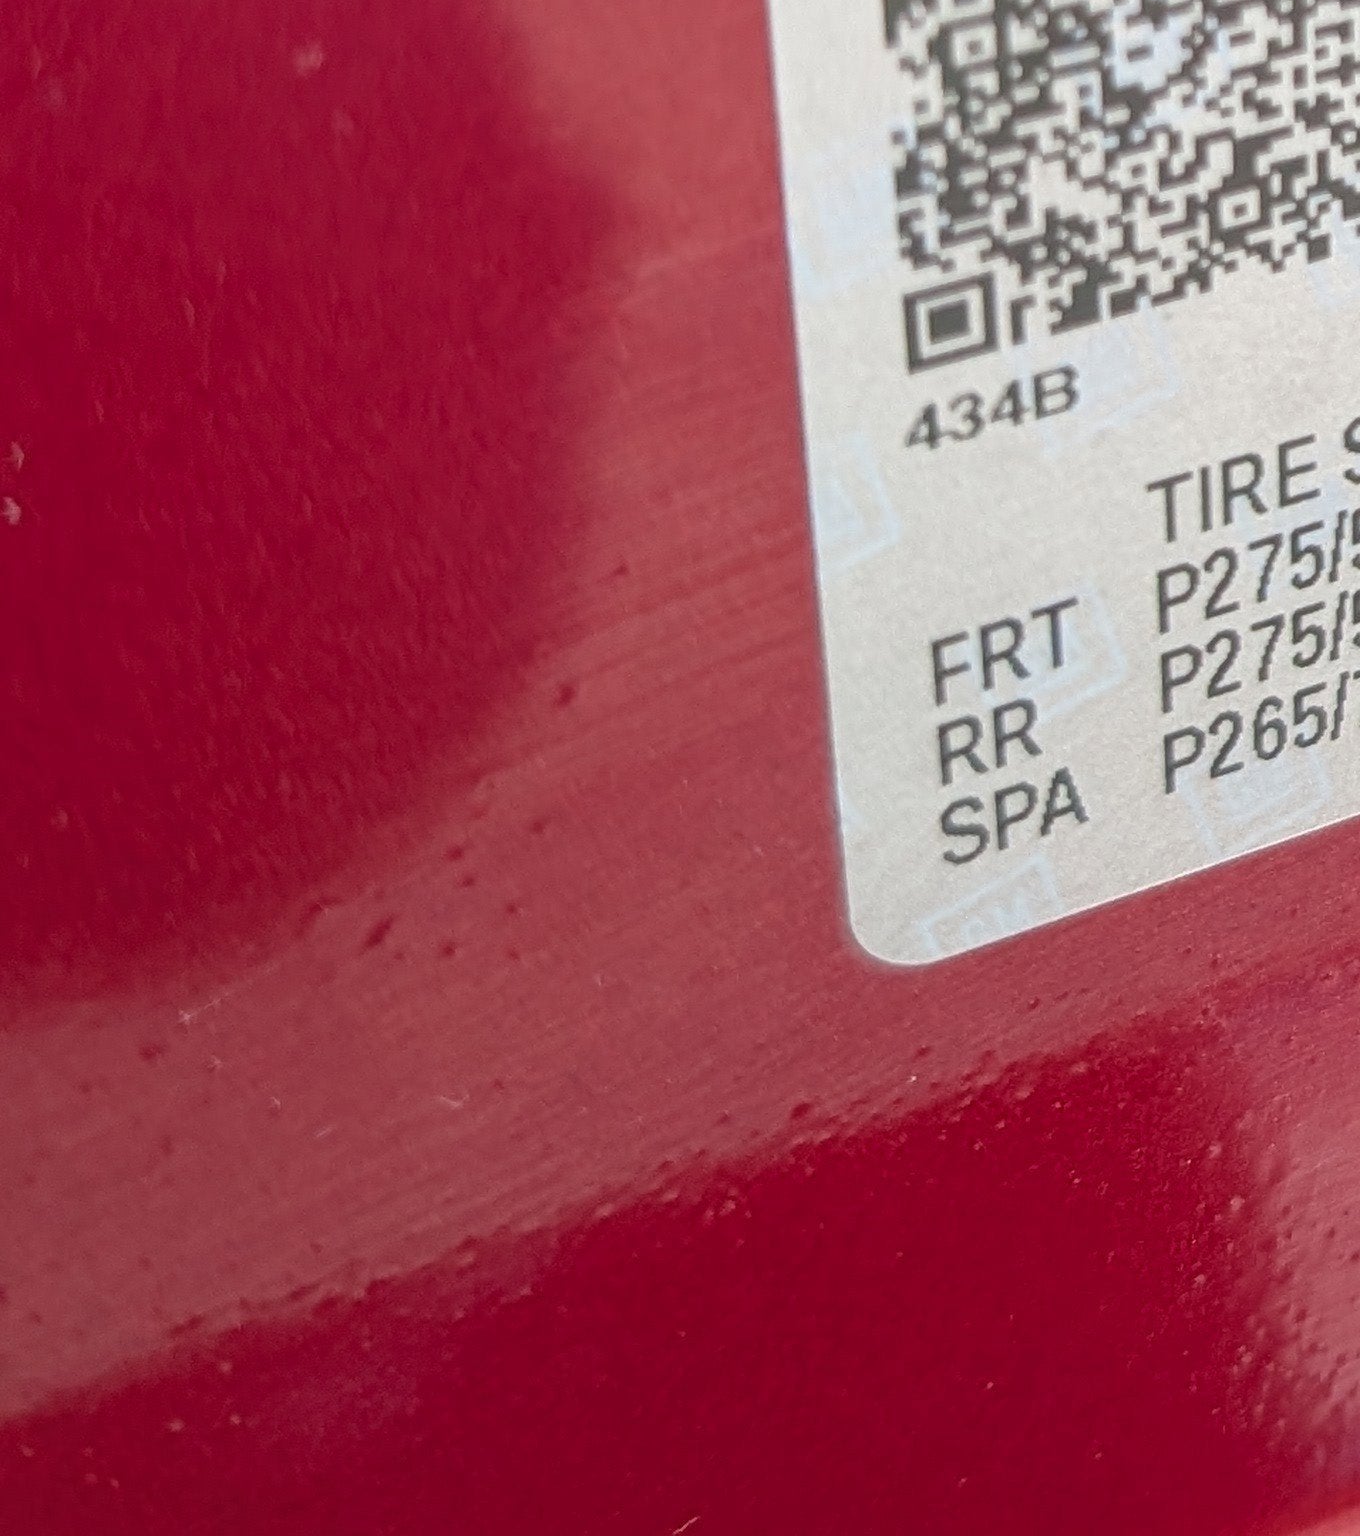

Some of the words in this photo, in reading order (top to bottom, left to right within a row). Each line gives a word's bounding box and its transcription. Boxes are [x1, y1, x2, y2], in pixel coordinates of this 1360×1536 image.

[904, 363, 1080, 452] 434B
[1145, 433, 1321, 543] TIRE
[931, 596, 1080, 706] FRT
[938, 697, 1042, 786] RR
[939, 767, 1088, 866] SPA
